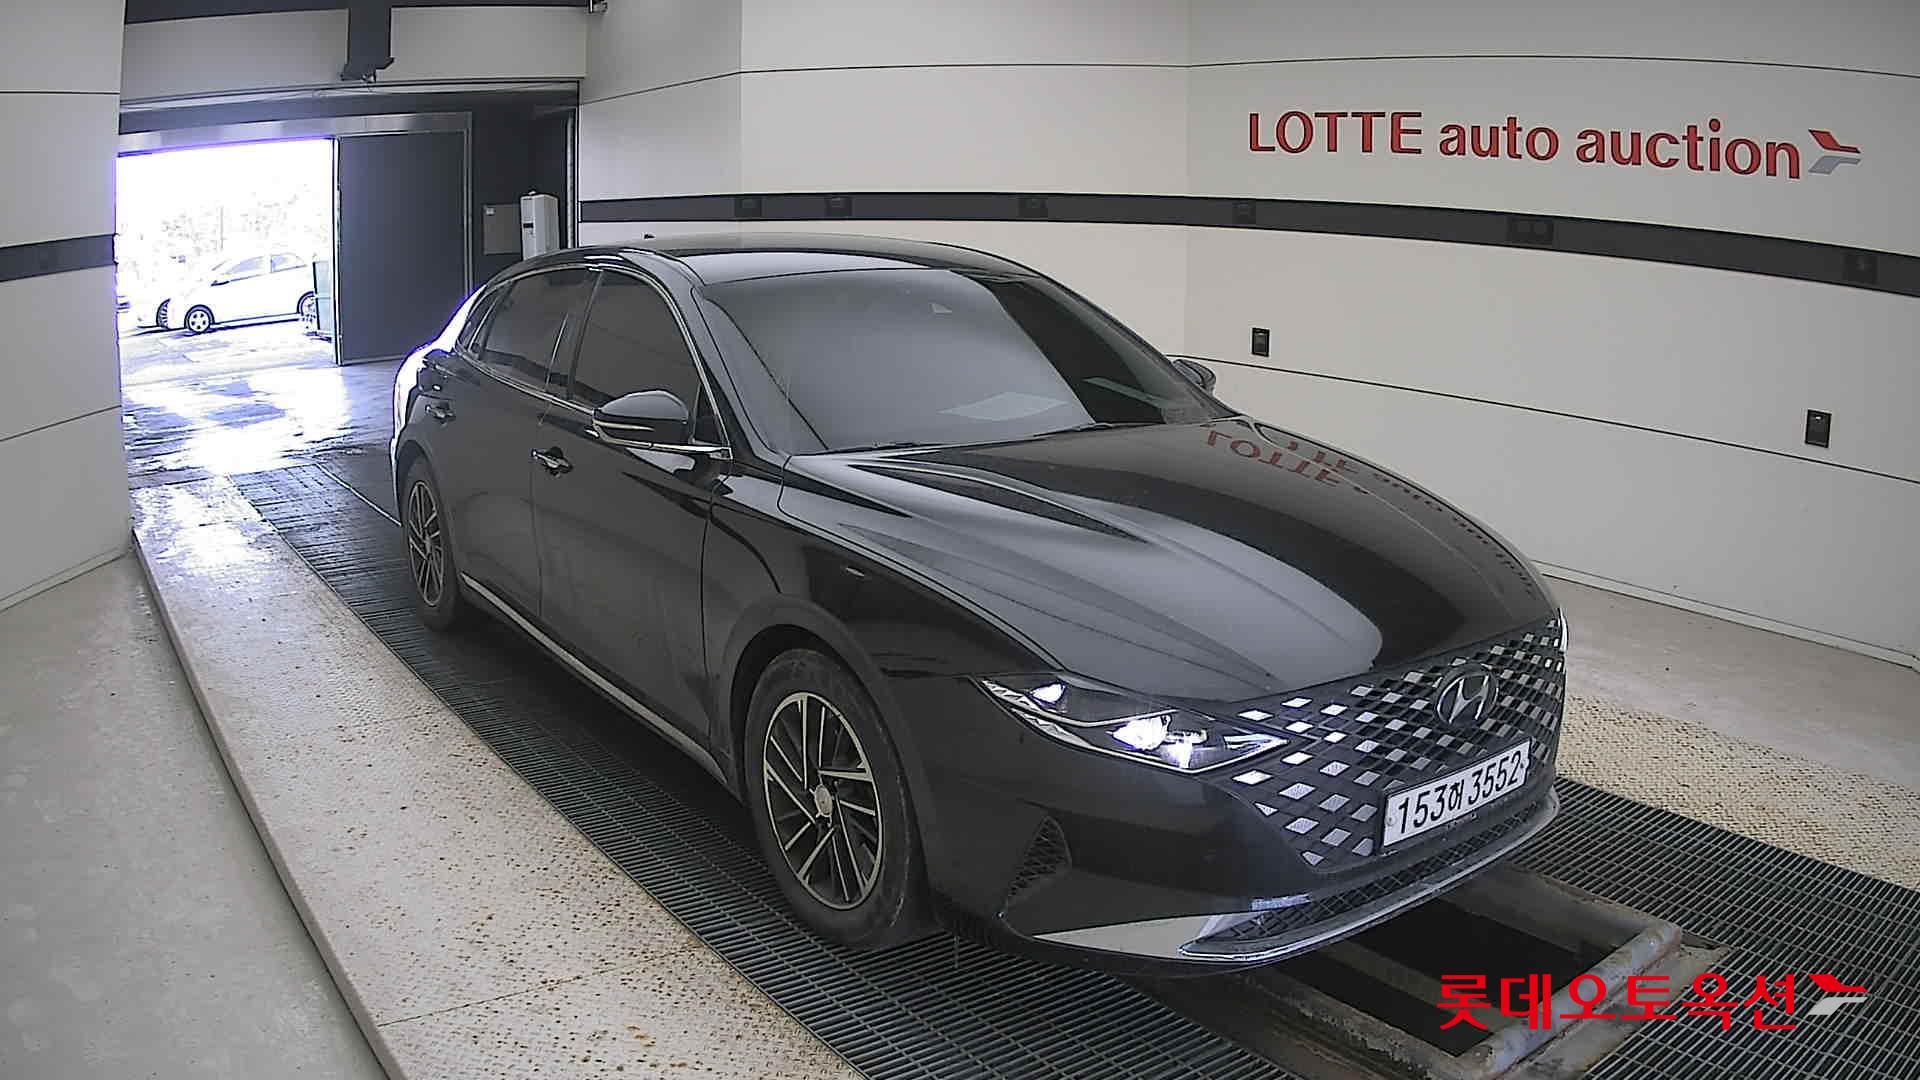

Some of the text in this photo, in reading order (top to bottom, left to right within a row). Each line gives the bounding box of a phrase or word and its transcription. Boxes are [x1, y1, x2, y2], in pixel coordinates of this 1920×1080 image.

[1249, 111, 1802, 179] LOTTE auto auction
[1398, 750, 1522, 834] 153허 3552
